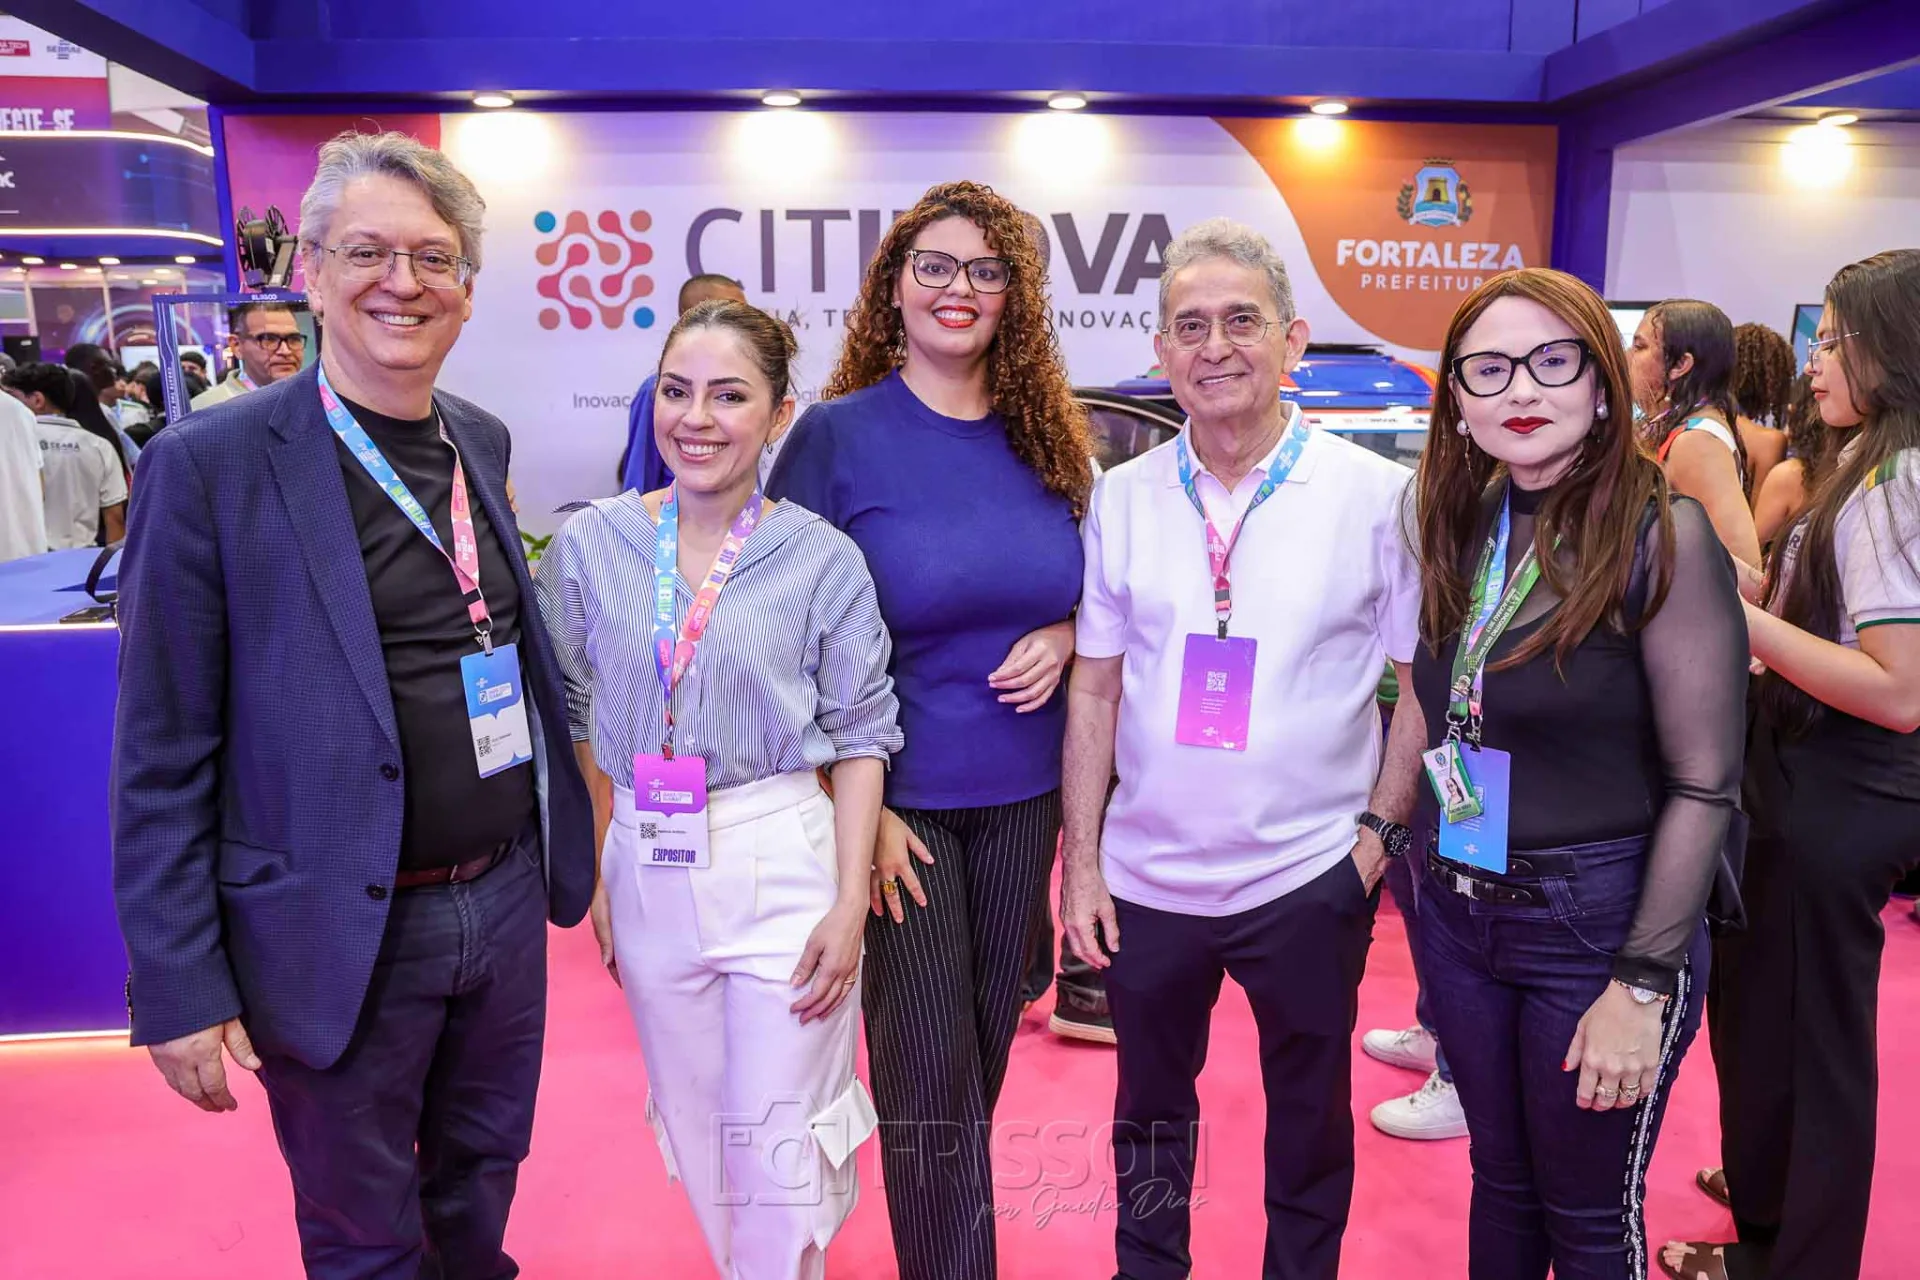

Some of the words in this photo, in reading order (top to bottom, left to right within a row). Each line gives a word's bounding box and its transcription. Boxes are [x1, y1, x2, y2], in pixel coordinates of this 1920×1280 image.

[686, 207, 1175, 294] CITIVA
[1337, 239, 1525, 270] FORTALEZA
[1361, 273, 1484, 291] PREFEITUR
[1058, 310, 1152, 334] NOVAÇ
[573, 392, 631, 410] Inovaç
[652, 848, 696, 863] EXPOSITOR
